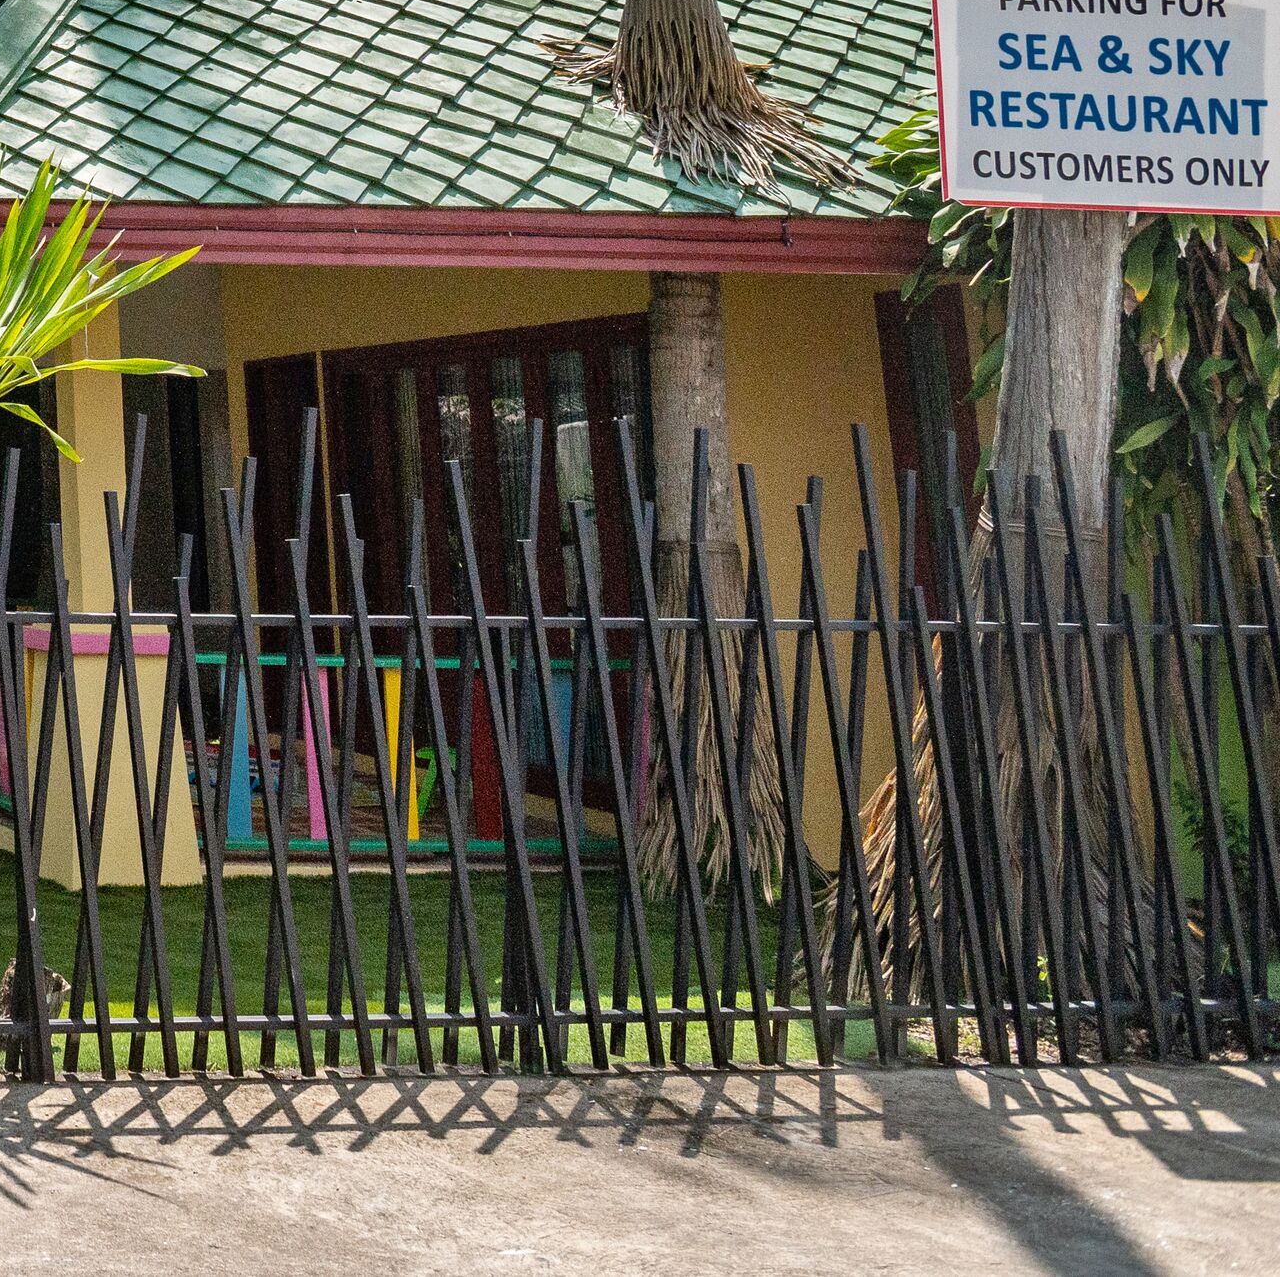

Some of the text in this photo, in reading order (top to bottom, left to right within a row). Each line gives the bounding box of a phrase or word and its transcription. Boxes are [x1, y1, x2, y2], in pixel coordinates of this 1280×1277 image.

[998, 32, 1231, 76] SEA & SKY
[969, 89, 1268, 136] RESTAURANT
[973, 149, 1270, 187] CUSTOMERS ONLY
